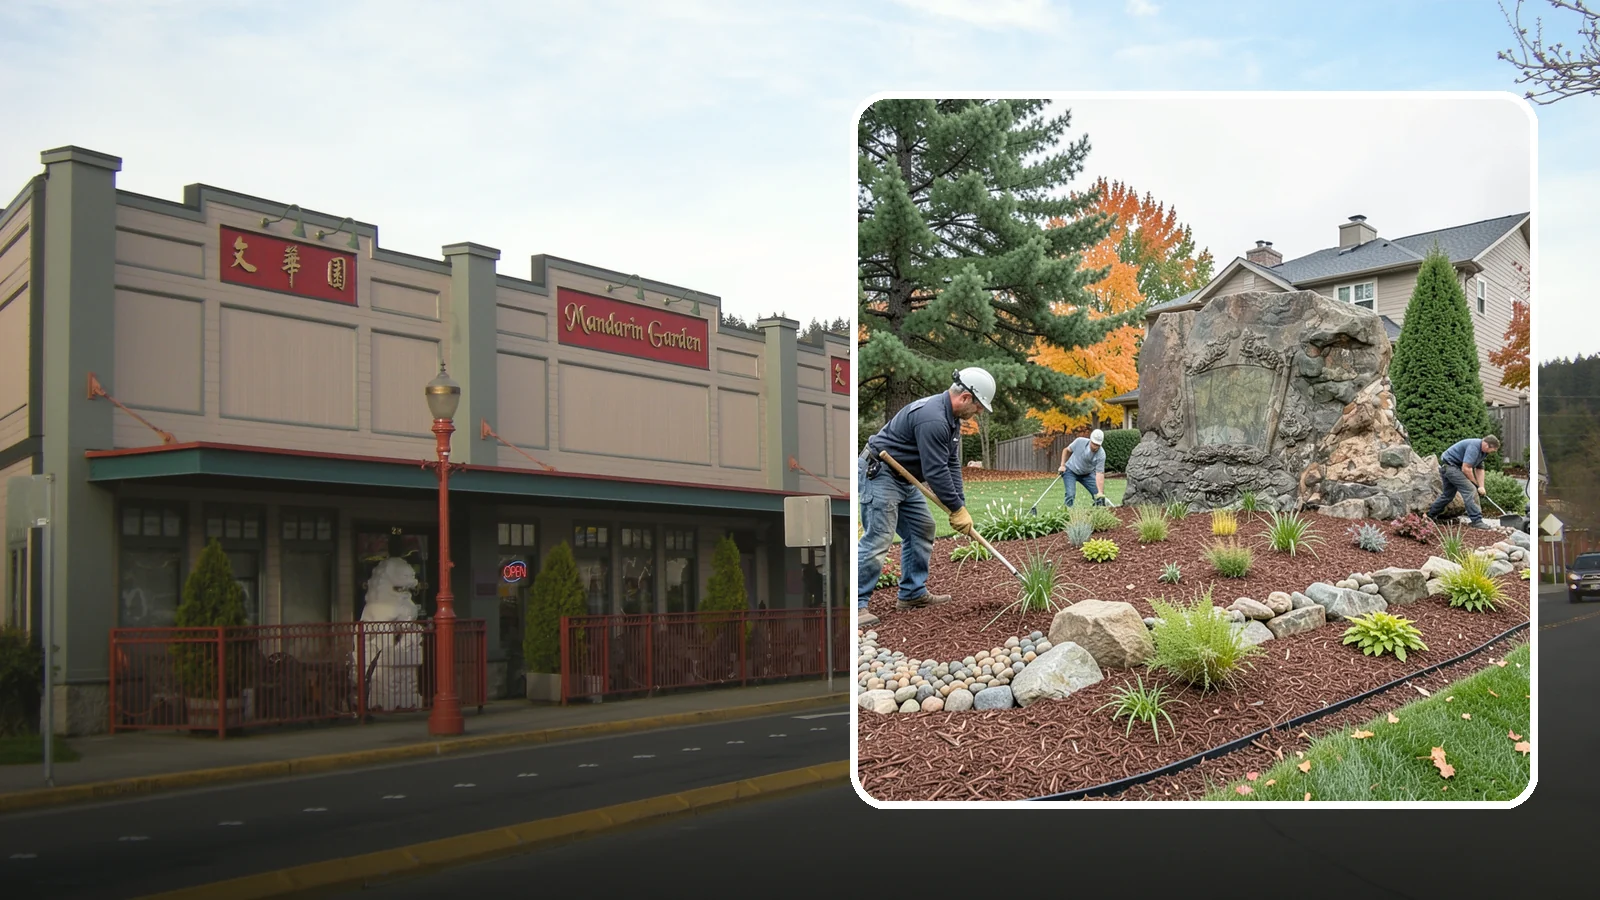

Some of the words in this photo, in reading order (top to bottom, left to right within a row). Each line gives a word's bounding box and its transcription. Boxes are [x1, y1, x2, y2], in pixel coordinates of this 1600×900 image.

[564, 302, 644, 341] Mandarin
[648, 320, 701, 352] Garden
[503, 565, 527, 578] OPEN
